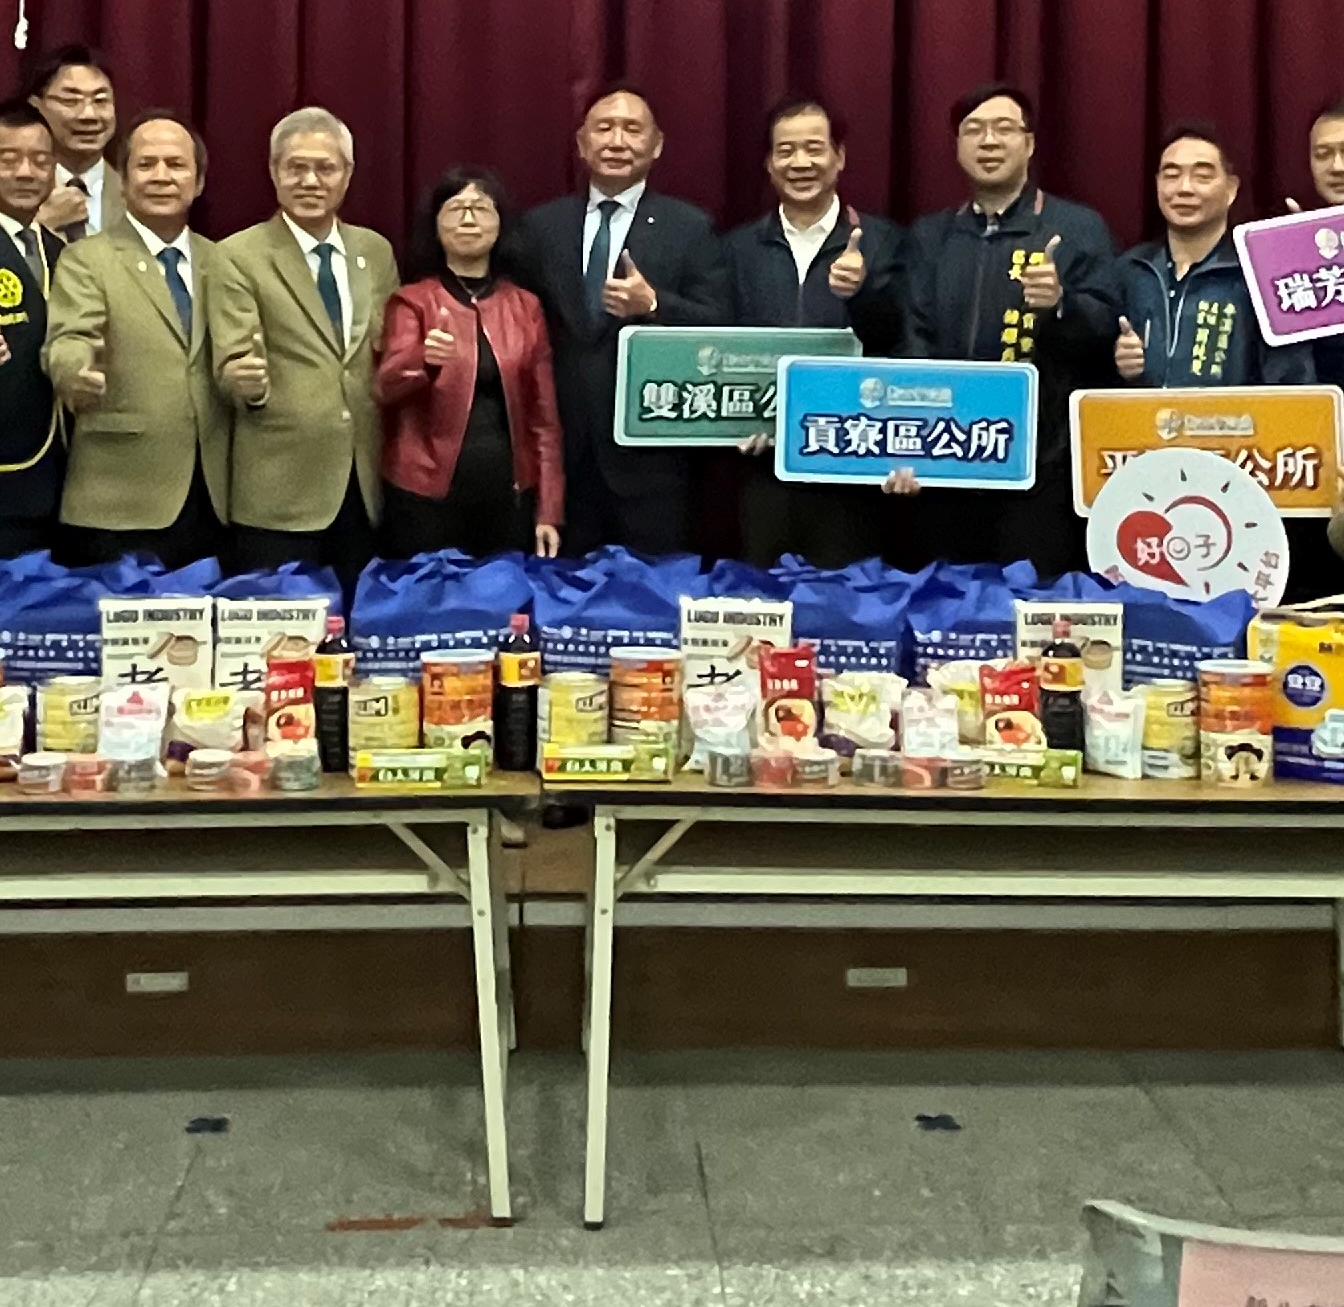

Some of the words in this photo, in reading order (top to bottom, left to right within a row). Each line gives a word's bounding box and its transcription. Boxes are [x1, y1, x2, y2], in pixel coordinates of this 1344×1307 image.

[801, 415, 1011, 461] 貢寮區公所
